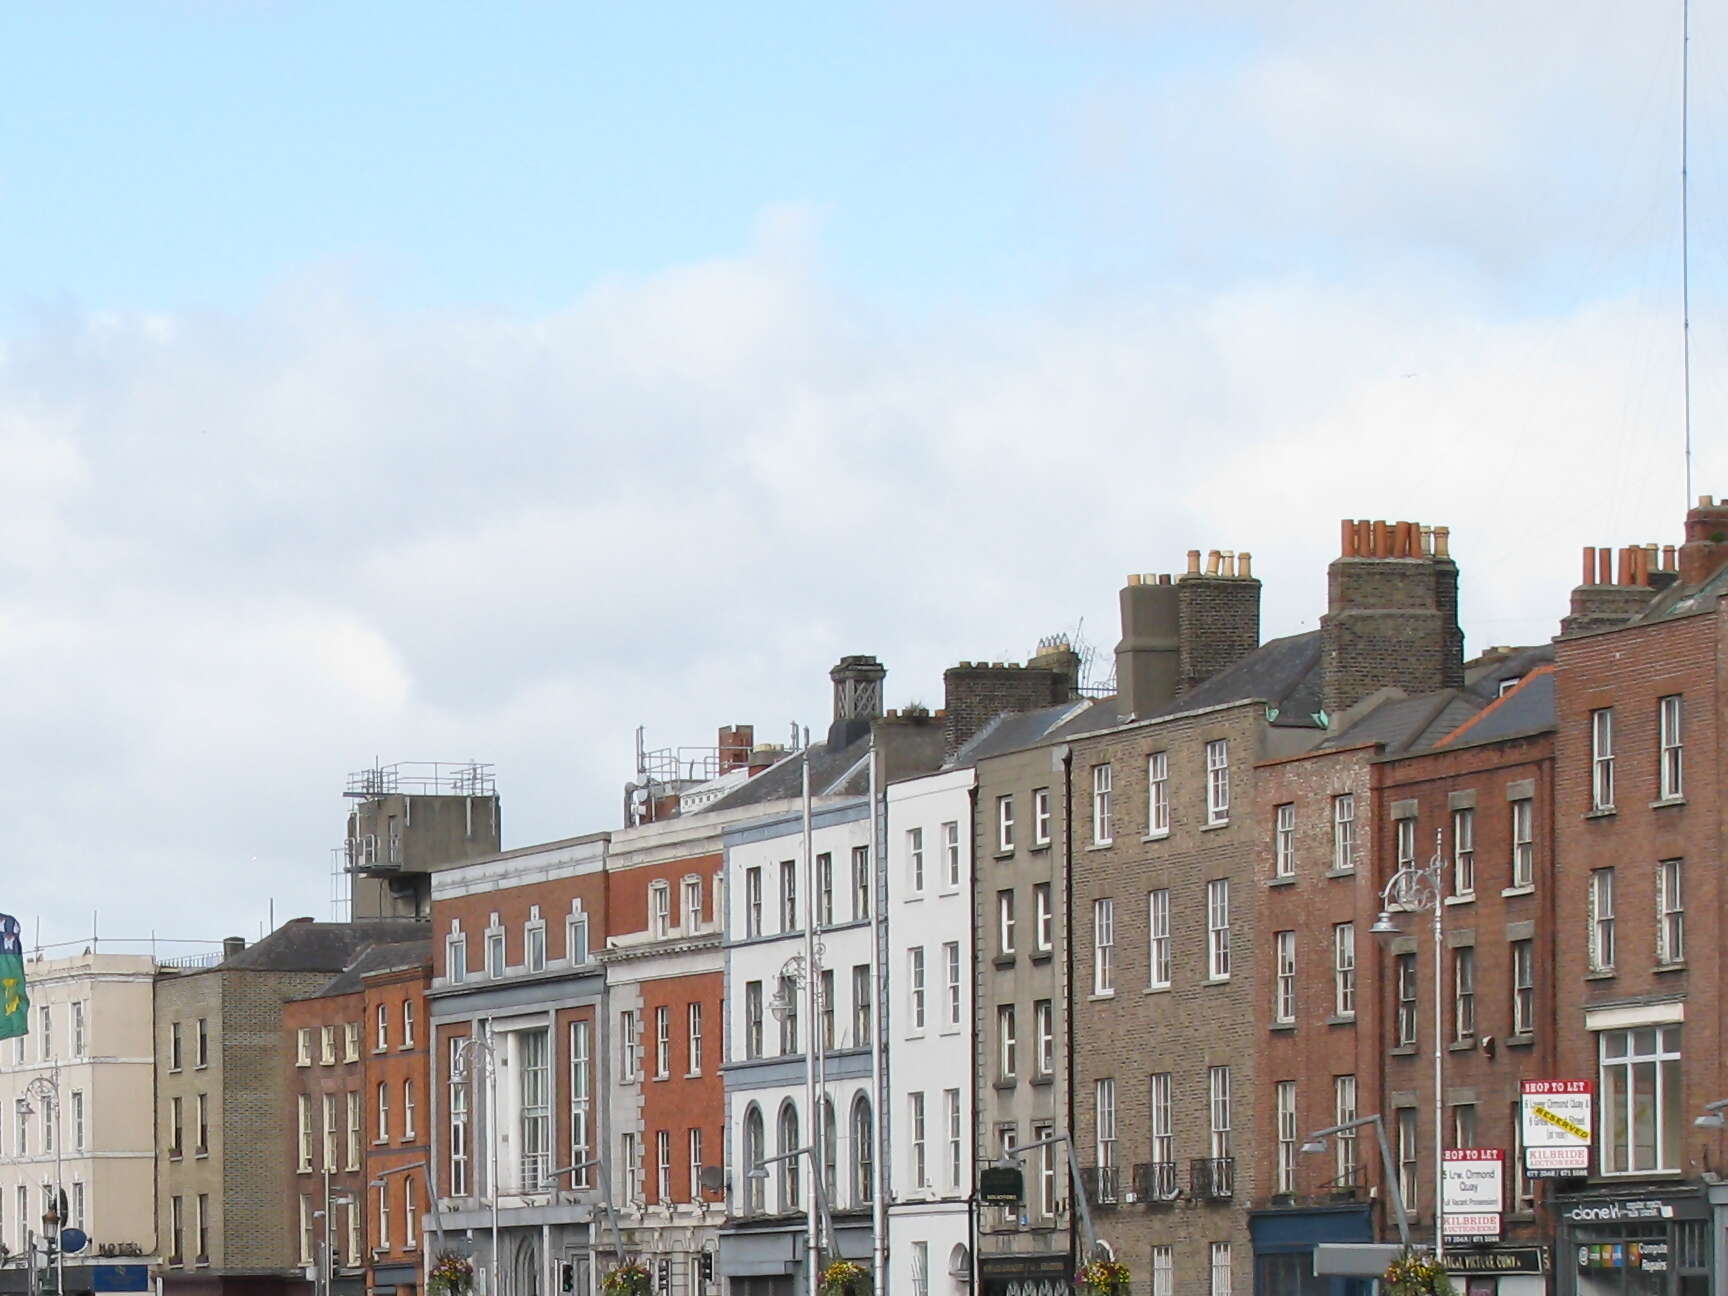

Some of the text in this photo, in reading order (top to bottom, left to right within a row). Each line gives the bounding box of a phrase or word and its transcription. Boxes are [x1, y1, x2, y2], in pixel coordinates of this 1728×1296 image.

[1525, 1081, 1585, 1092] SHOP TO LET
[1535, 1106, 1589, 1139] RESERVED
[1442, 1150, 1498, 1160] HOP TO LET
[1529, 1149, 1585, 1160] KILBRIDE
[1465, 1169, 1495, 1180] Ormond
[1459, 1181, 1478, 1192] Quay
